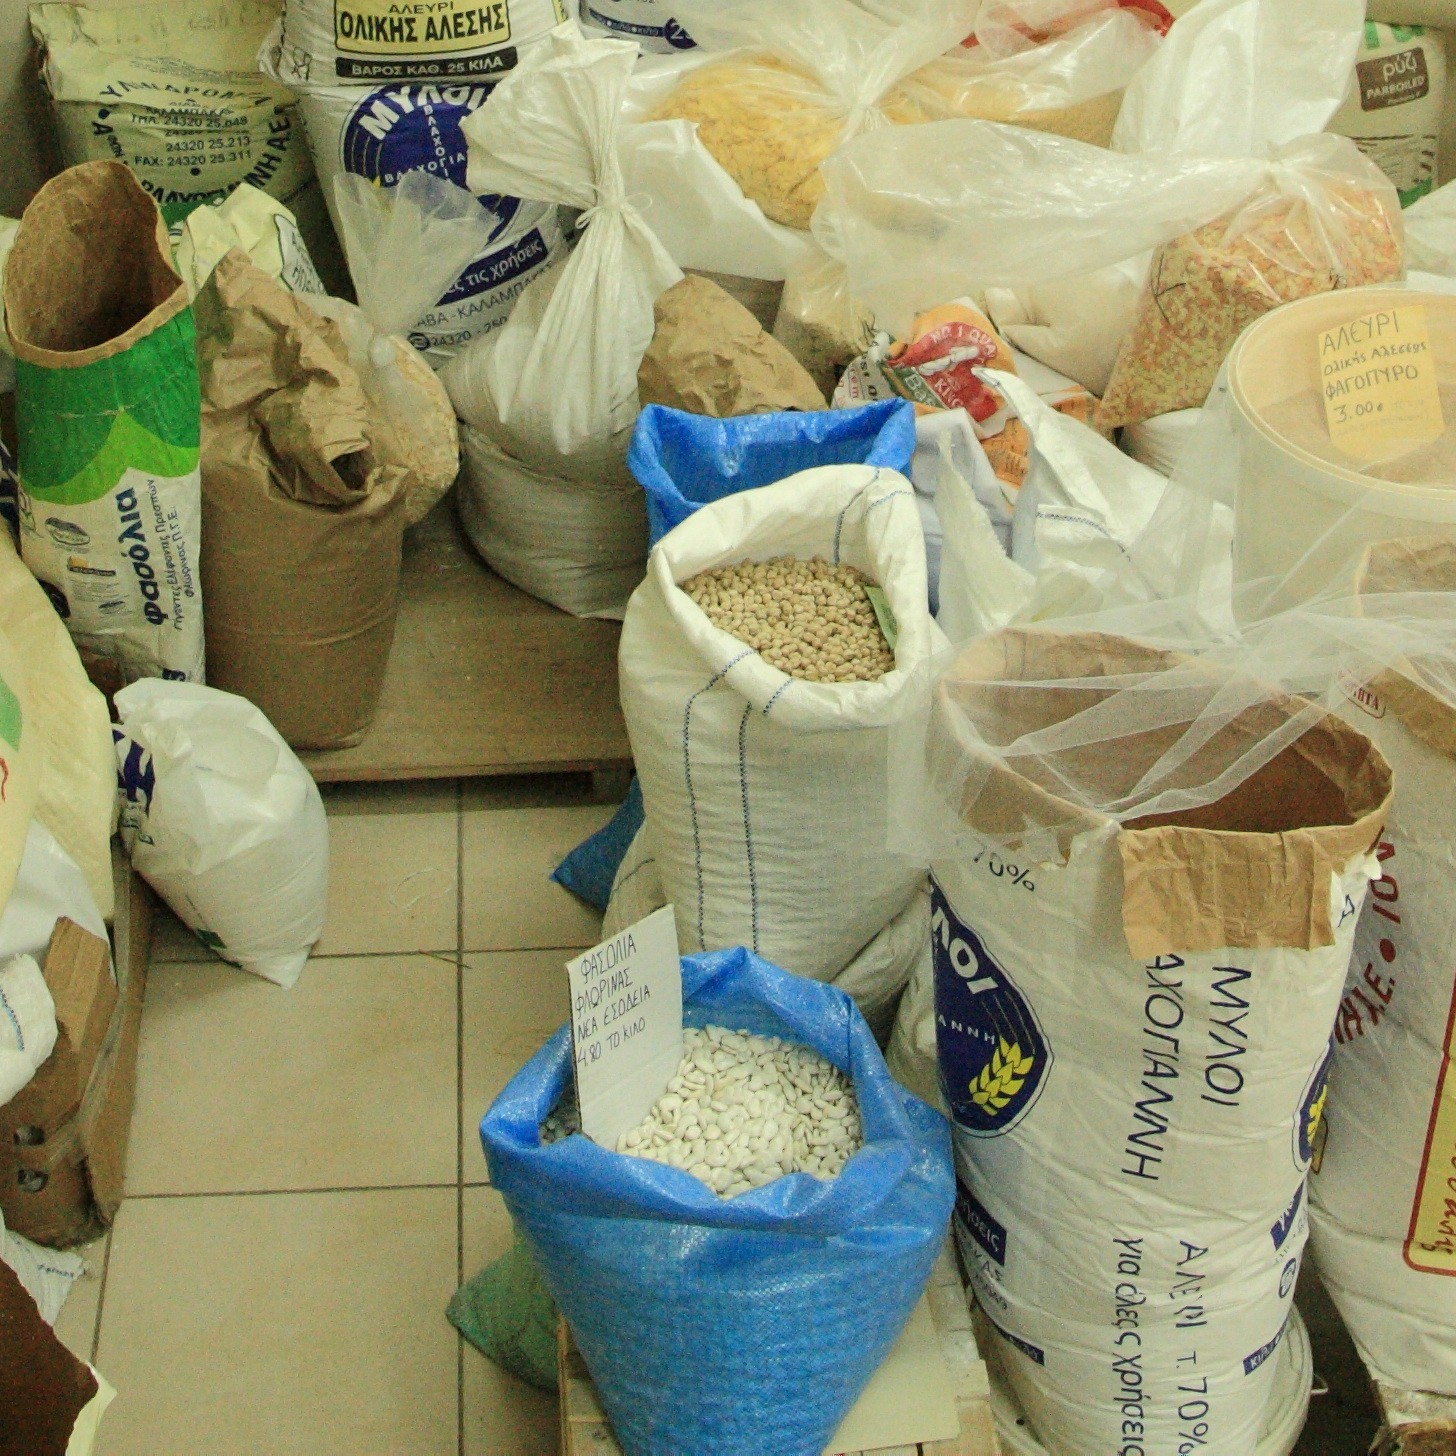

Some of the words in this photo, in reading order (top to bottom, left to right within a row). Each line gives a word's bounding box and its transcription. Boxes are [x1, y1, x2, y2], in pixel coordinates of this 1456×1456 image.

[340, 10, 418, 43] ΟΛΙΚΗΣ
[424, 2, 506, 42] ΑΛΕΣΗΣ
[389, 0, 455, 15] ΑΛΕΥΡΙ
[351, 62, 403, 77] ΒΑΡΟΣ
[405, 63, 442, 76] ΚΑΘ.
[447, 61, 465, 75] 25
[468, 56, 504, 72] ΚΙΛΑ
[1382, 51, 1419, 84] ρύζι
[164, 116, 202, 128] 24320
[357, 85, 486, 140] ΜΥΛΟΙ
[134, 155, 164, 167] FAX:
[166, 154, 206, 167] 24320
[209, 150, 252, 164] 25.311
[165, 139, 205, 153] 24320
[208, 136, 251, 150] 25.213
[465, 270, 490, 288] τις
[491, 238, 543, 283] χρήσεις
[1322, 310, 1400, 356] ΑΛΕΥΡΙ
[1325, 364, 1419, 402] ΦΑΓΟΠΥΡΟ
[115, 487, 169, 626] φασόλια
[580, 933, 637, 985] ΦΑΣΟΛΙΑ
[577, 1016, 599, 1044] ΝΕΑ
[603, 984, 651, 1026] ΕΣΟΔΕΙΑ
[607, 1032, 621, 1051] ΤΟ
[623, 1016, 647, 1040] ΚΙΛΟ
[1200, 965, 1252, 1107] ΜΥΛΟΙ
[1112, 1237, 1144, 1277] για
[1175, 1376, 1210, 1456] 70%
